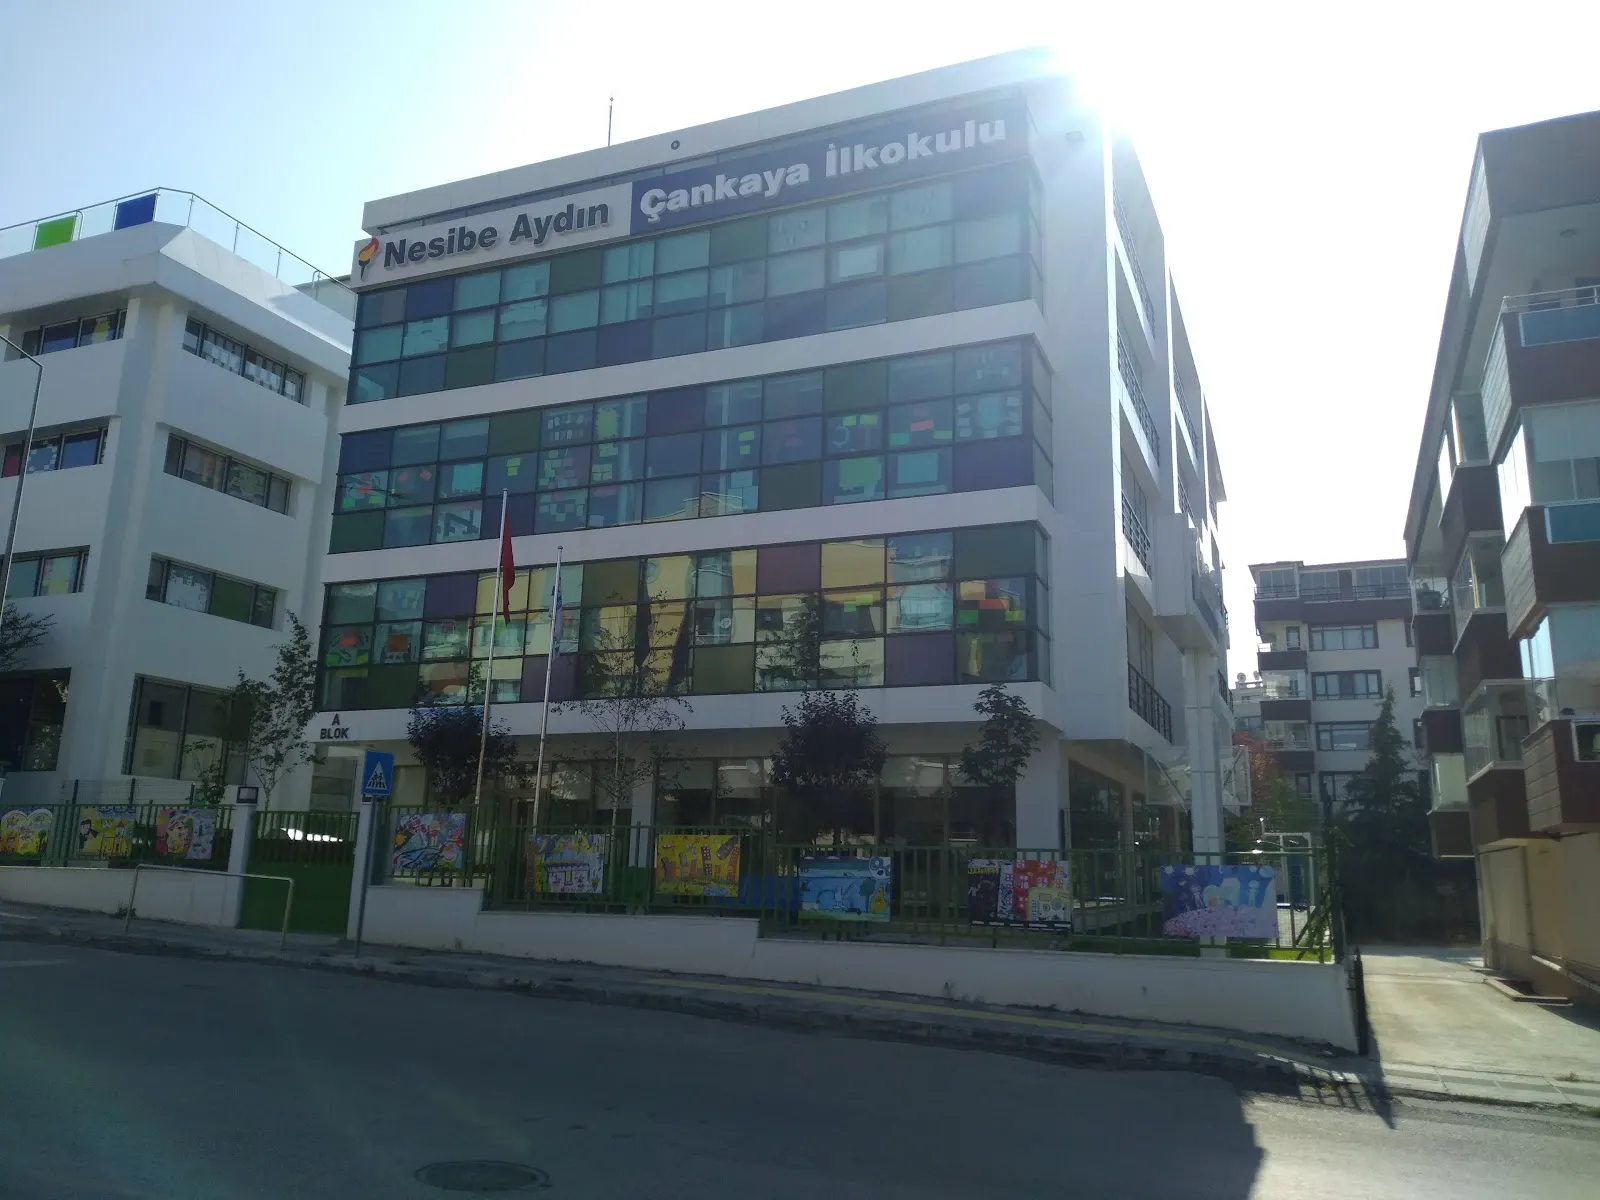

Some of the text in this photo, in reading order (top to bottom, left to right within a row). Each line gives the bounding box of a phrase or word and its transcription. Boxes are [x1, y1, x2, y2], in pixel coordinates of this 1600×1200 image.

[640, 119, 1007, 222] Çankaya İlkokulu
[383, 203, 609, 268] Nesibe Aydın
[320, 727, 350, 740] BLOK
[331, 713, 340, 726] A
